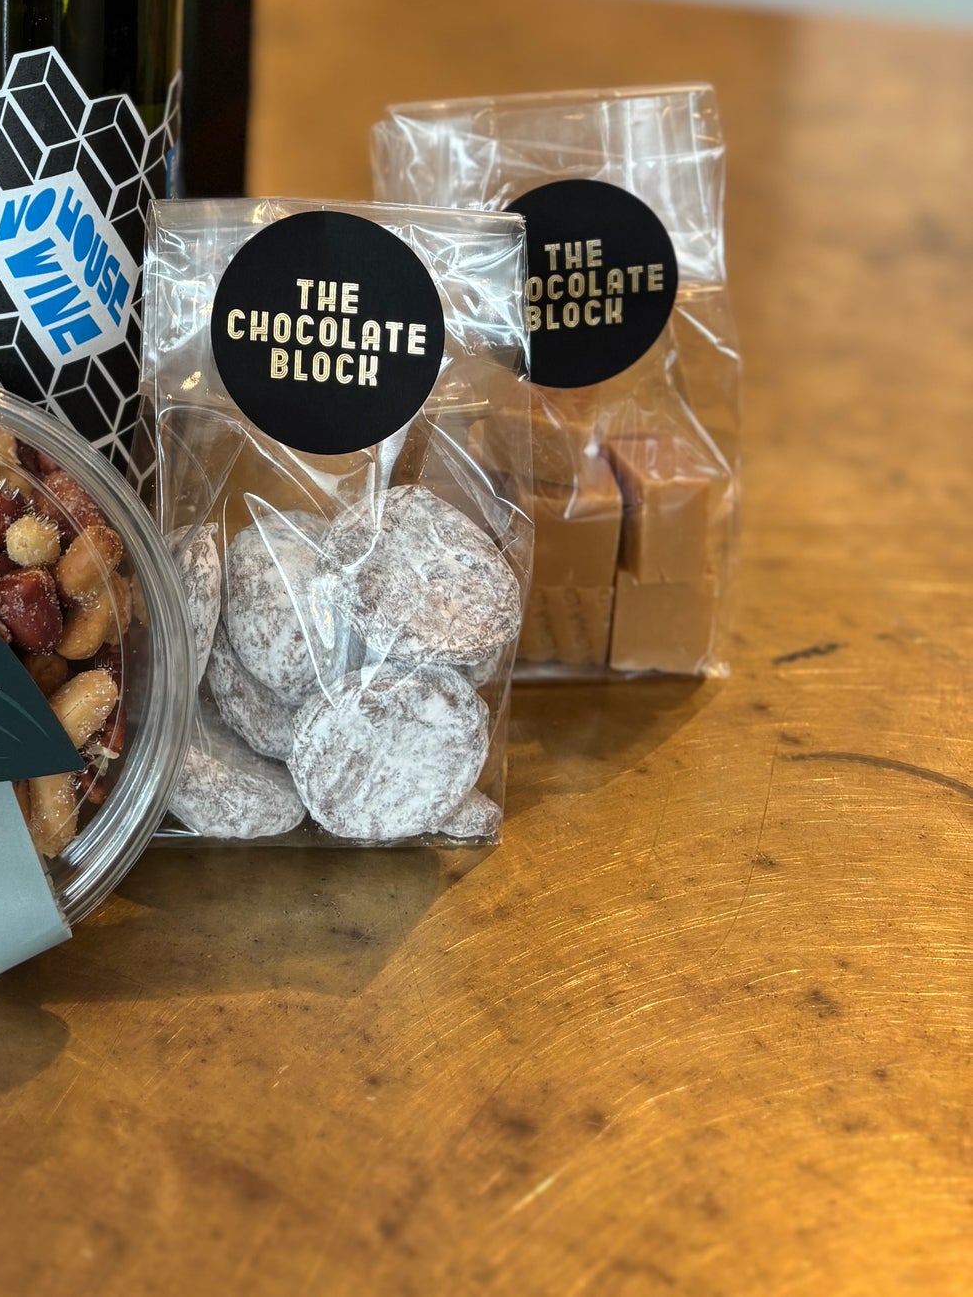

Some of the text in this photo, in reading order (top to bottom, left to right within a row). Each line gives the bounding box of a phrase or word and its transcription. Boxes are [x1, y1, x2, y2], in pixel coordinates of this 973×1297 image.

[55, 186, 130, 328] HOUSE
[544, 238, 603, 271] THE
[4, 237, 103, 356] WINE
[296, 278, 360, 314] THE
[526, 297, 624, 332] BLOCK
[227, 308, 427, 355] CHOCOLATE
[270, 347, 379, 387] BLOCK
